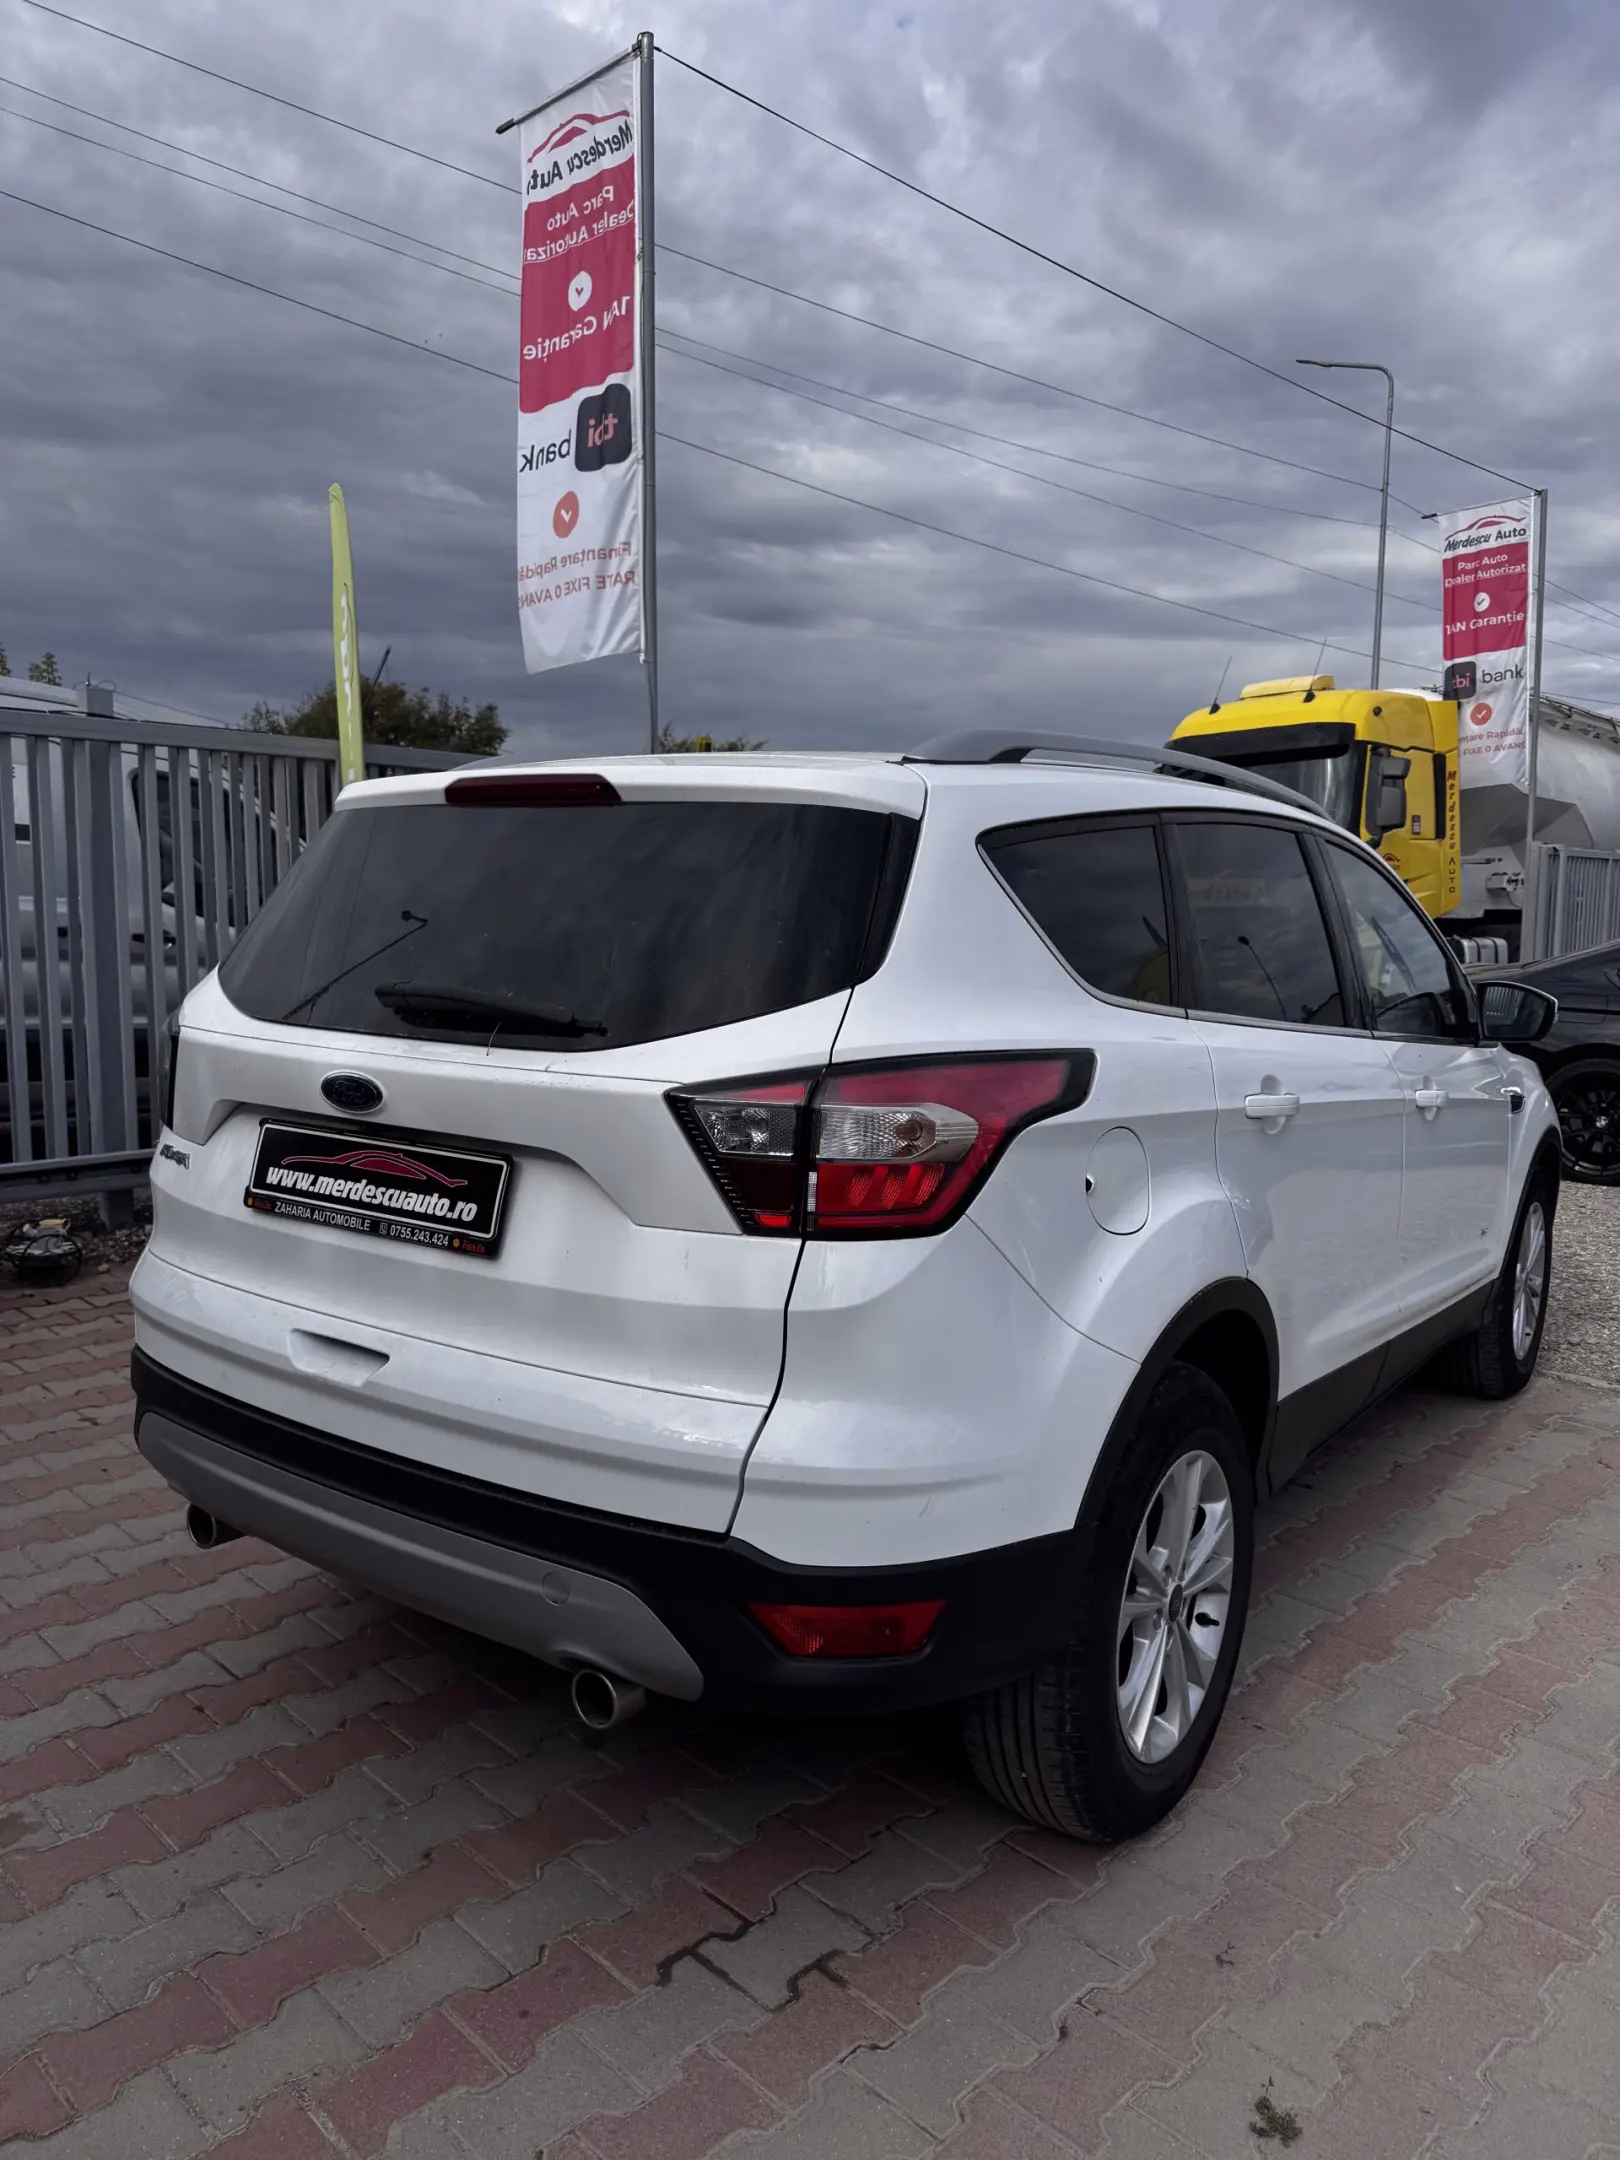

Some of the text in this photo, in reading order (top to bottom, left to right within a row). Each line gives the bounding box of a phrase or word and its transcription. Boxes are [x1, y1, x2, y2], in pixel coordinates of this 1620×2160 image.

[1444, 526, 1527, 553] Merdescu Auto
[1481, 553, 1508, 566] Auto
[1476, 563, 1526, 579] Autorizat
[1469, 611, 1524, 630] Garanție
[1481, 664, 1524, 684] bank
[1463, 746, 1483, 756] FIXE
[1494, 740, 1526, 752] AVANS
[1447, 769, 1457, 851] Merdescu
[265, 1166, 478, 1222] www.merdescuauto.ro
[274, 1201, 311, 1219] ZAHARIA
[312, 1209, 371, 1231] AUTOMOBILE
[389, 1224, 449, 1247] 0755.243.424
